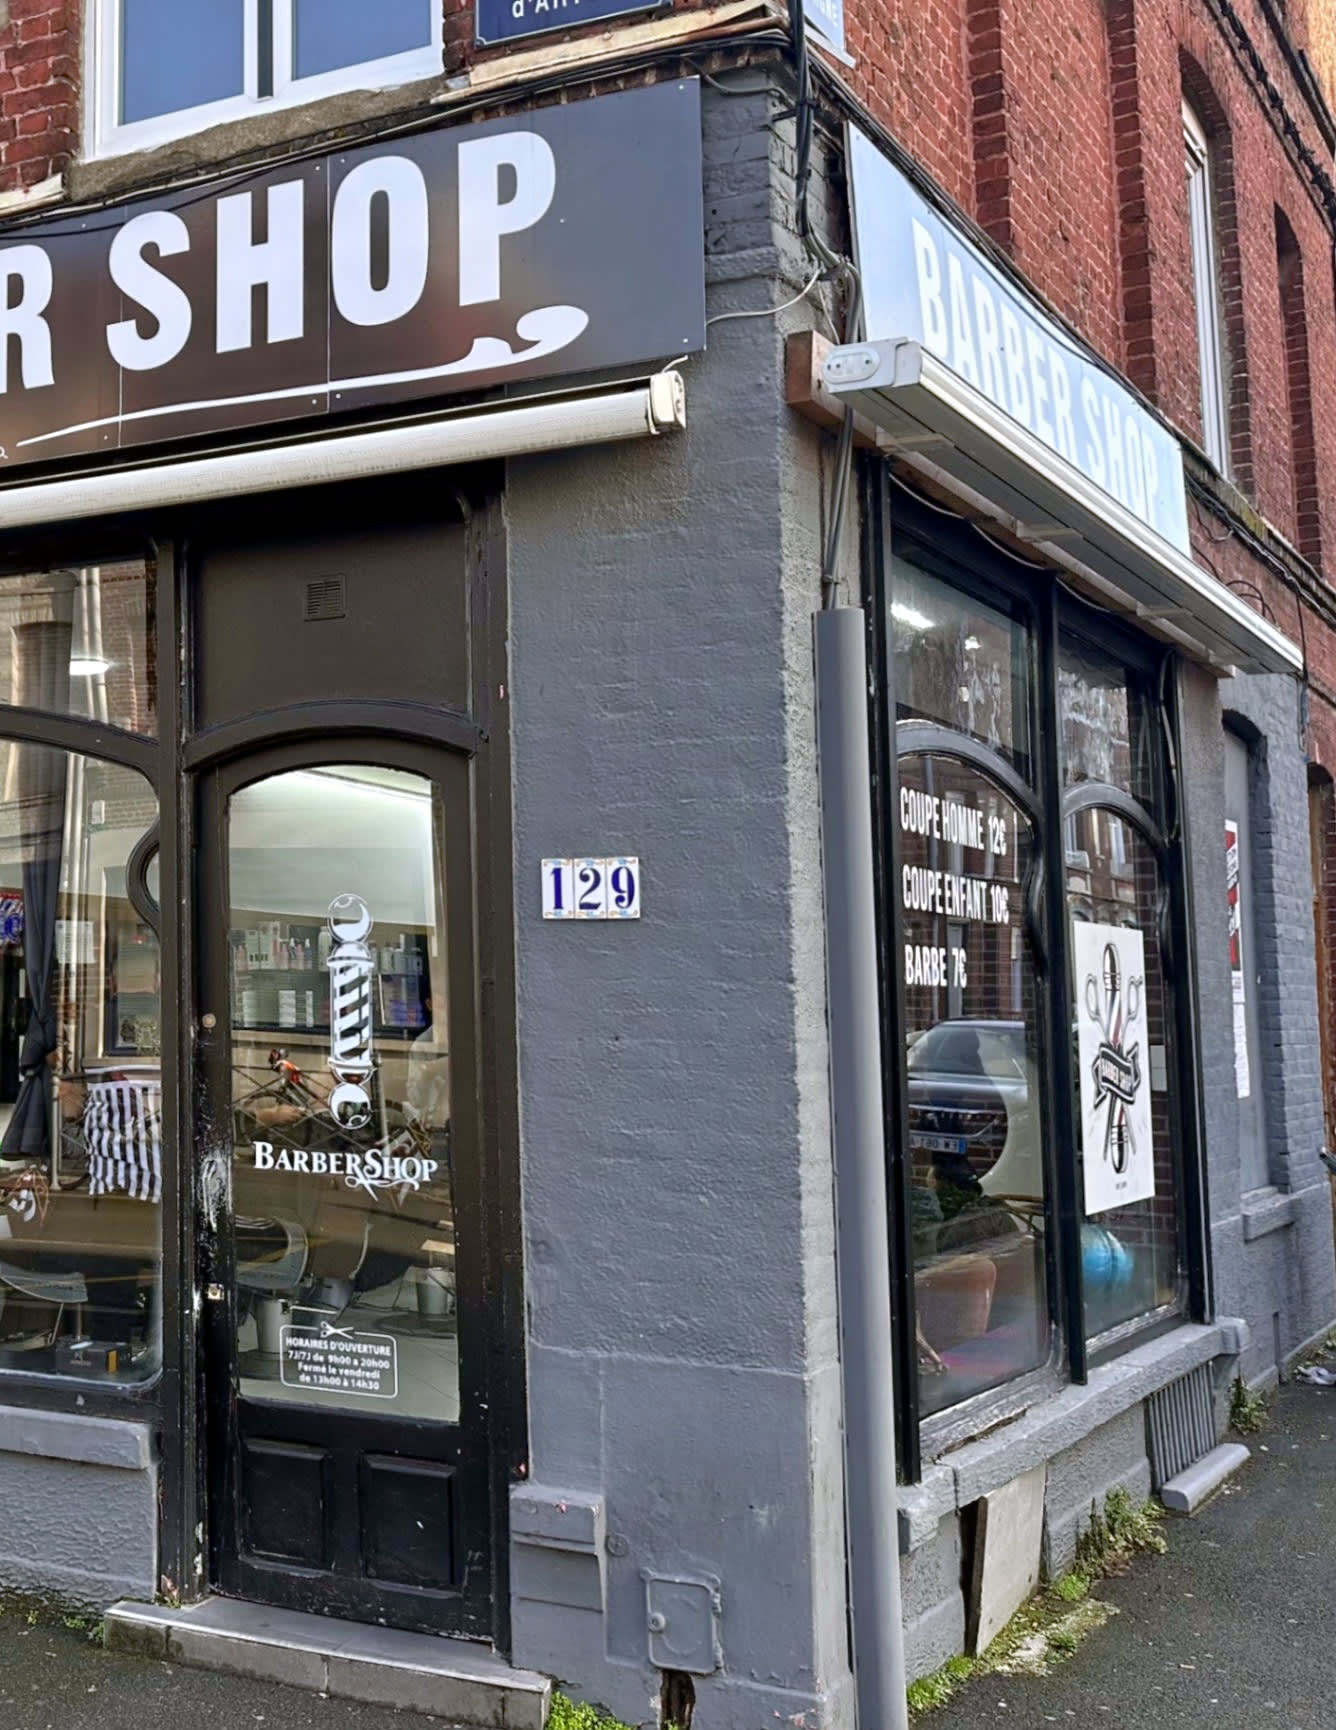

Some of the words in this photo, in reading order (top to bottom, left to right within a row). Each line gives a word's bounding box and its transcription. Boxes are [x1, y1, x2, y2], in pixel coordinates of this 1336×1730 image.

[106, 131, 556, 371] SHOP
[912, 216, 1078, 464] BARBER
[1080, 376, 1159, 527] SHOP
[900, 786, 941, 839] COUPE
[942, 799, 985, 850] HOMME
[988, 815, 1007, 856] 12€
[551, 866, 635, 910] 129
[903, 864, 944, 913] COUPE
[944, 873, 987, 920] ENFANT
[990, 884, 1009, 924] 10€
[905, 944, 948, 987] BARBE
[952, 947, 968, 988] 7€
[286, 1337, 328, 1350] HORAIRES
[330, 1341, 391, 1356] D'OUVERTURE
[312, 1352, 324, 1362] de
[361, 1357, 390, 1369] 20h00
[299, 1373, 311, 1383] de
[328, 1364, 337, 1375] le
[339, 1367, 380, 1379] vendredi
